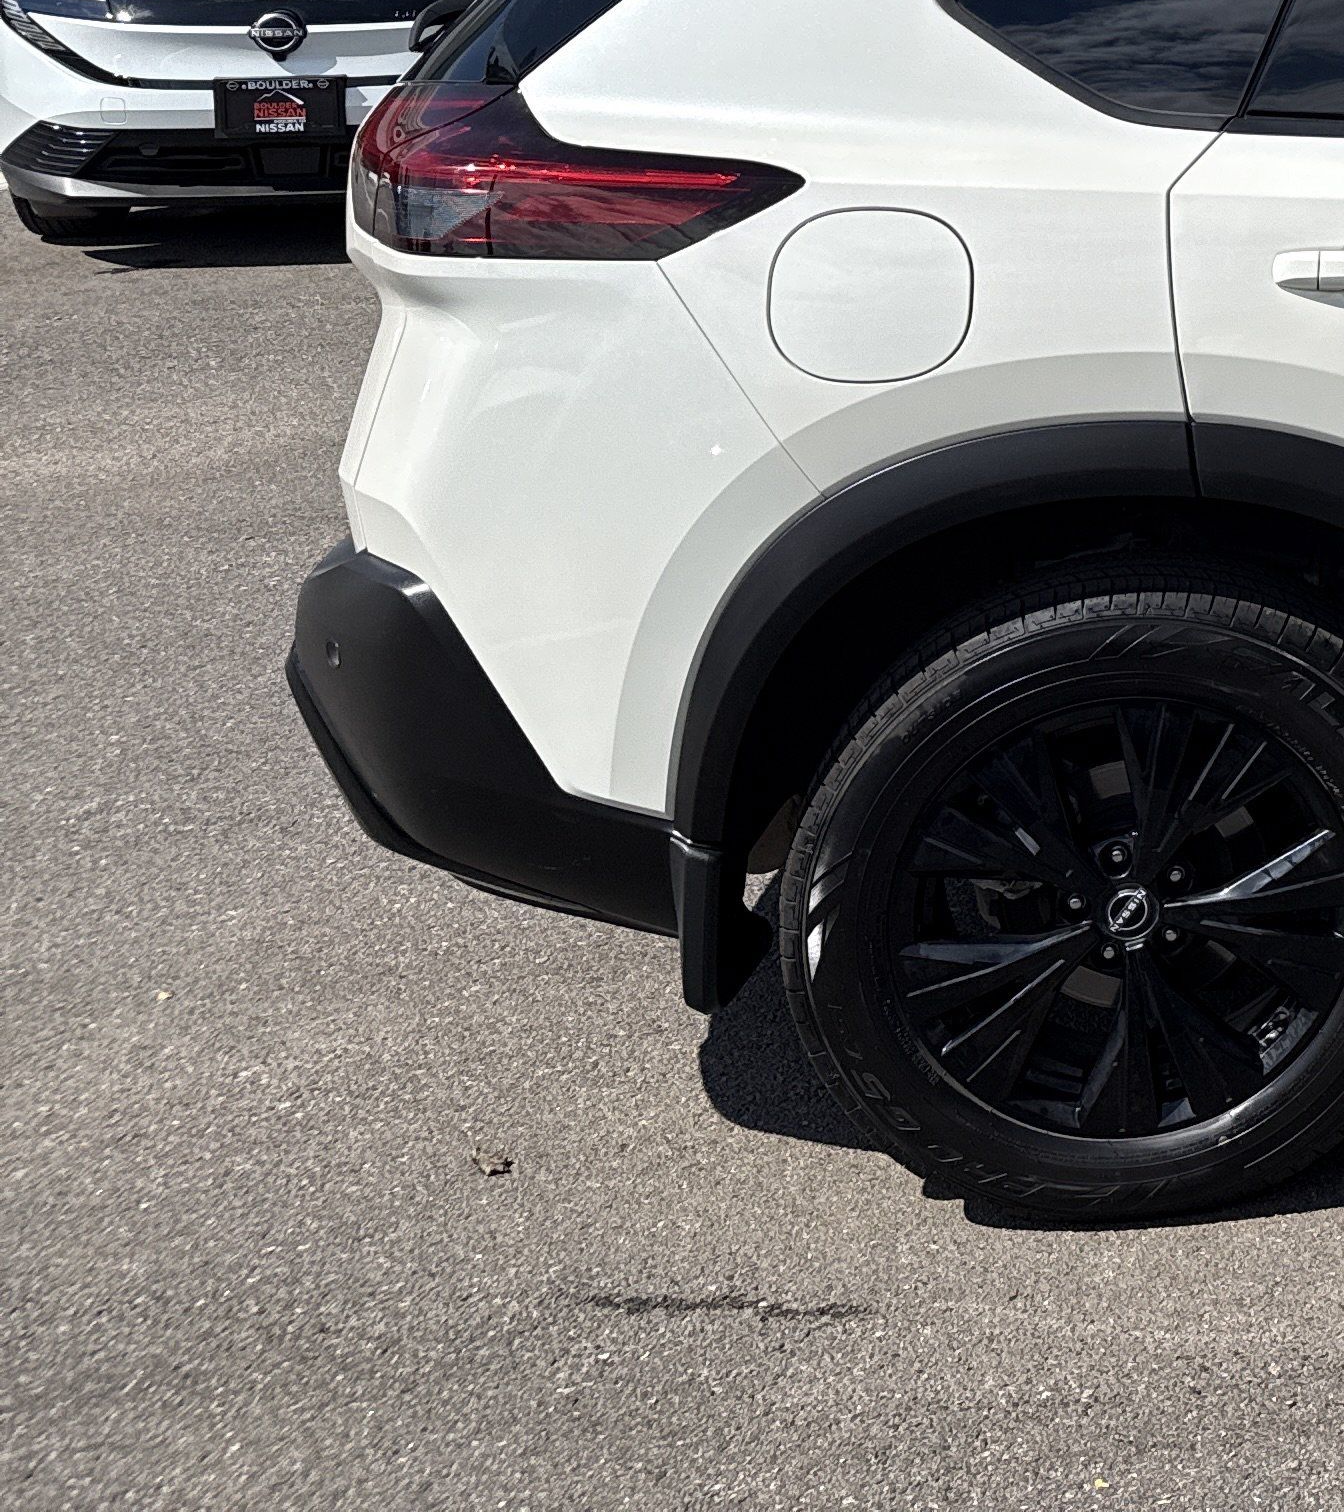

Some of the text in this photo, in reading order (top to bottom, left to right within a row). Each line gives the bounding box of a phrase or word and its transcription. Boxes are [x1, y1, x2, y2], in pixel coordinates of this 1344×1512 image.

[251, 28, 303, 37] NISSAN
[248, 79, 308, 89] BOULDER
[254, 108, 306, 118] NISSAN
[256, 123, 304, 132] NISSAN
[1109, 888, 1147, 932] NISSAN
